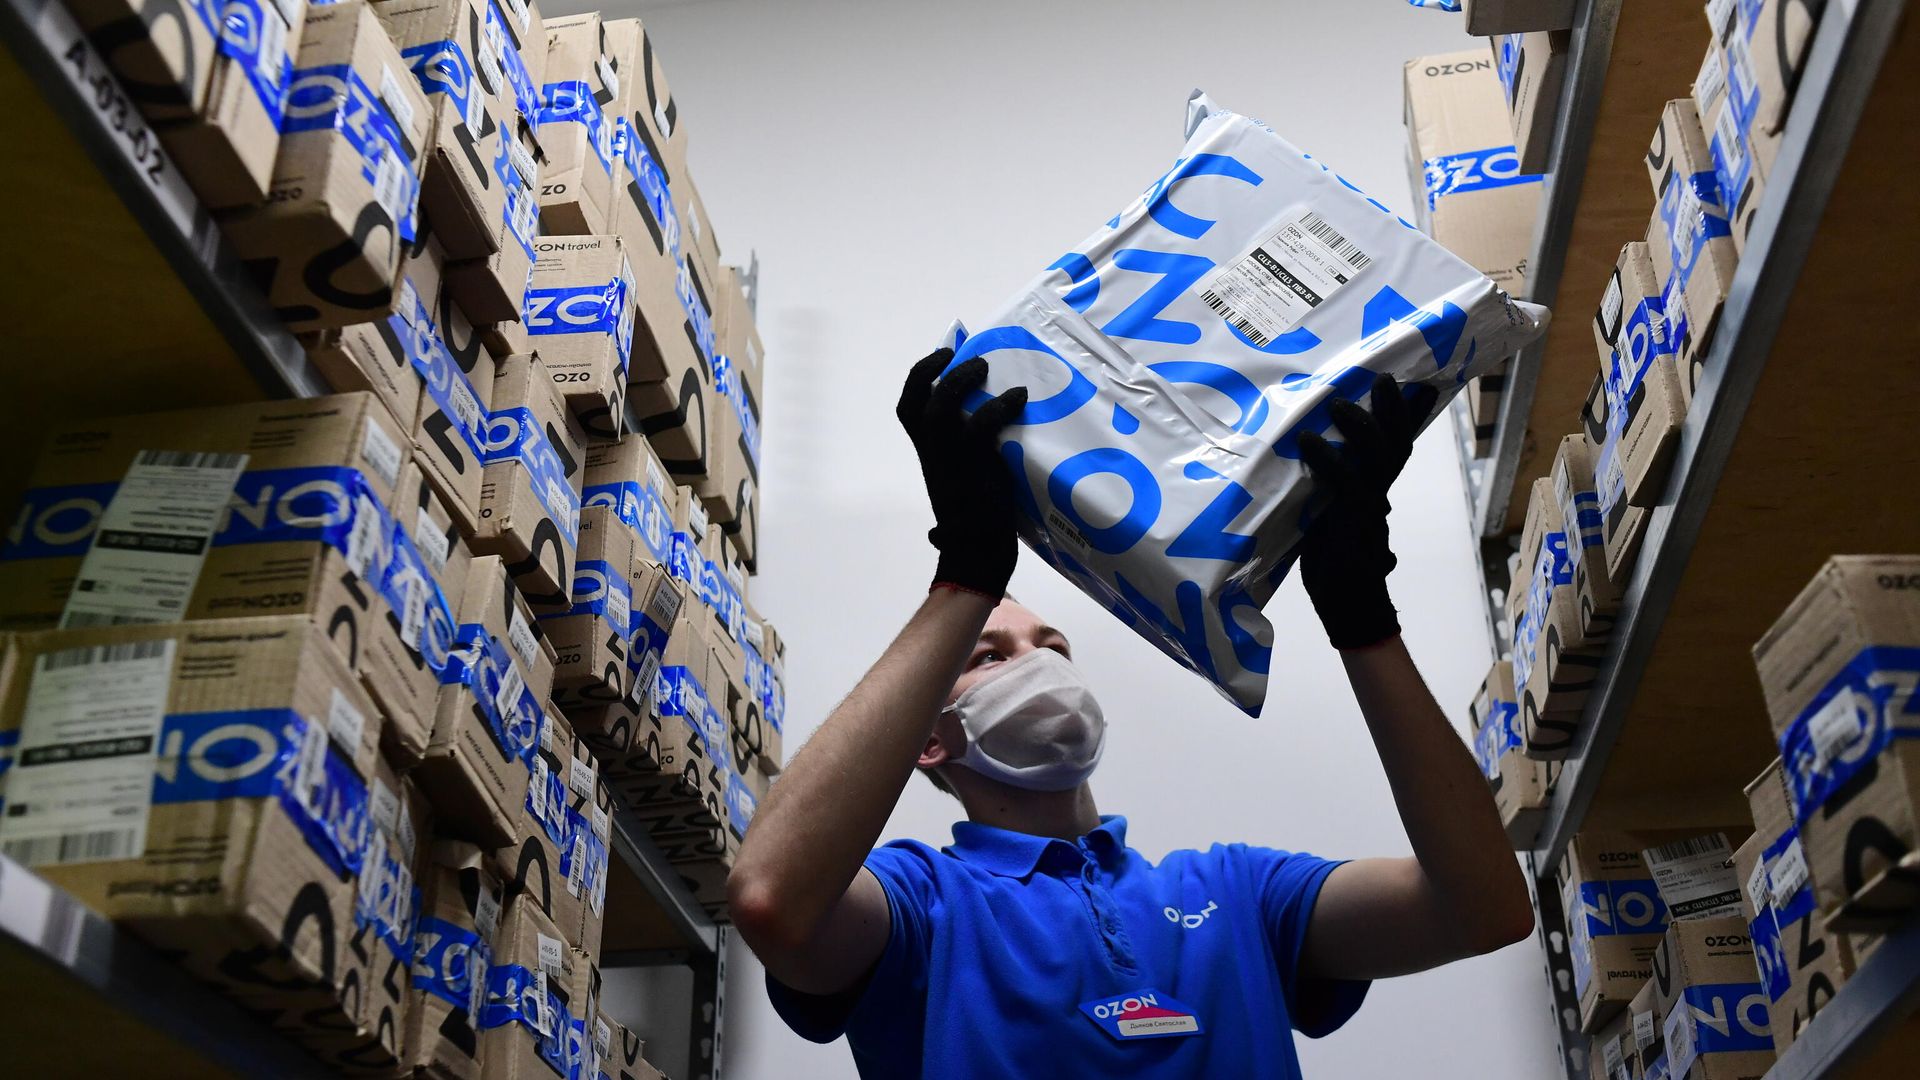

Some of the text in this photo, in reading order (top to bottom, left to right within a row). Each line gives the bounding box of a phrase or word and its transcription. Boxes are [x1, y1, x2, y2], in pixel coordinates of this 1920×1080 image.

[1425, 61, 1490, 77] OZON
[1286, 225, 1303, 239] OZON
[567, 241, 601, 251] travel
[553, 372, 591, 383] OZO
[578, 520, 593, 531] vel
[633, 570, 643, 580] el
[1599, 851, 1639, 862] OZON
[1607, 969, 1637, 981] travel
[1093, 993, 1158, 1019] OZON
